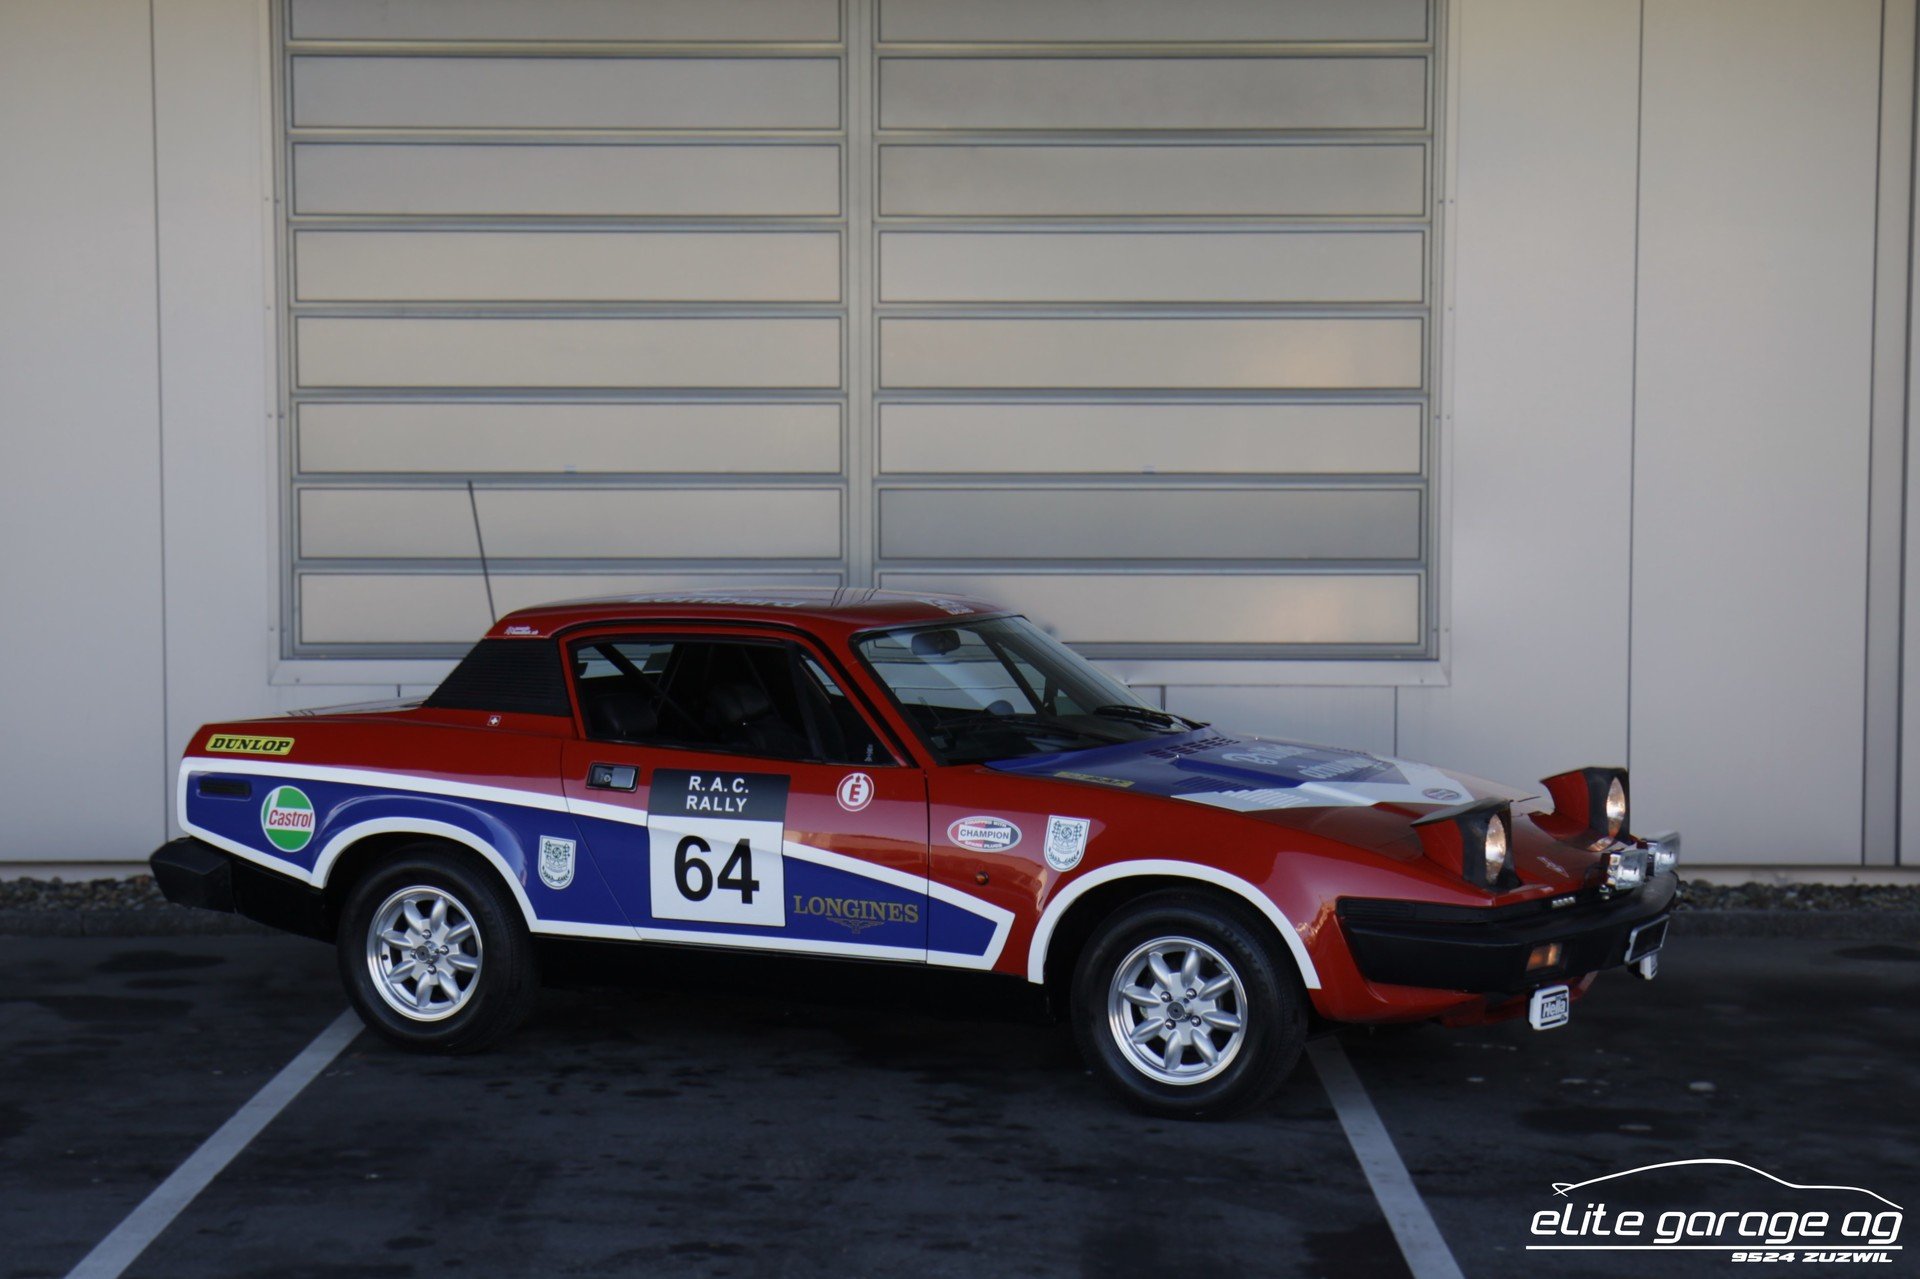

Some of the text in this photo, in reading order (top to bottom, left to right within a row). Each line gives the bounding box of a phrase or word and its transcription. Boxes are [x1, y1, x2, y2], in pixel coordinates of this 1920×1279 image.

[210, 737, 290, 752] DUNLOP
[685, 795, 748, 813] RALLY
[268, 809, 312, 828] Castrol
[960, 829, 1009, 839] CHAMPION
[674, 835, 760, 905] 64
[793, 895, 919, 924] LONGINES
[1543, 1000, 1566, 1018] Hella
